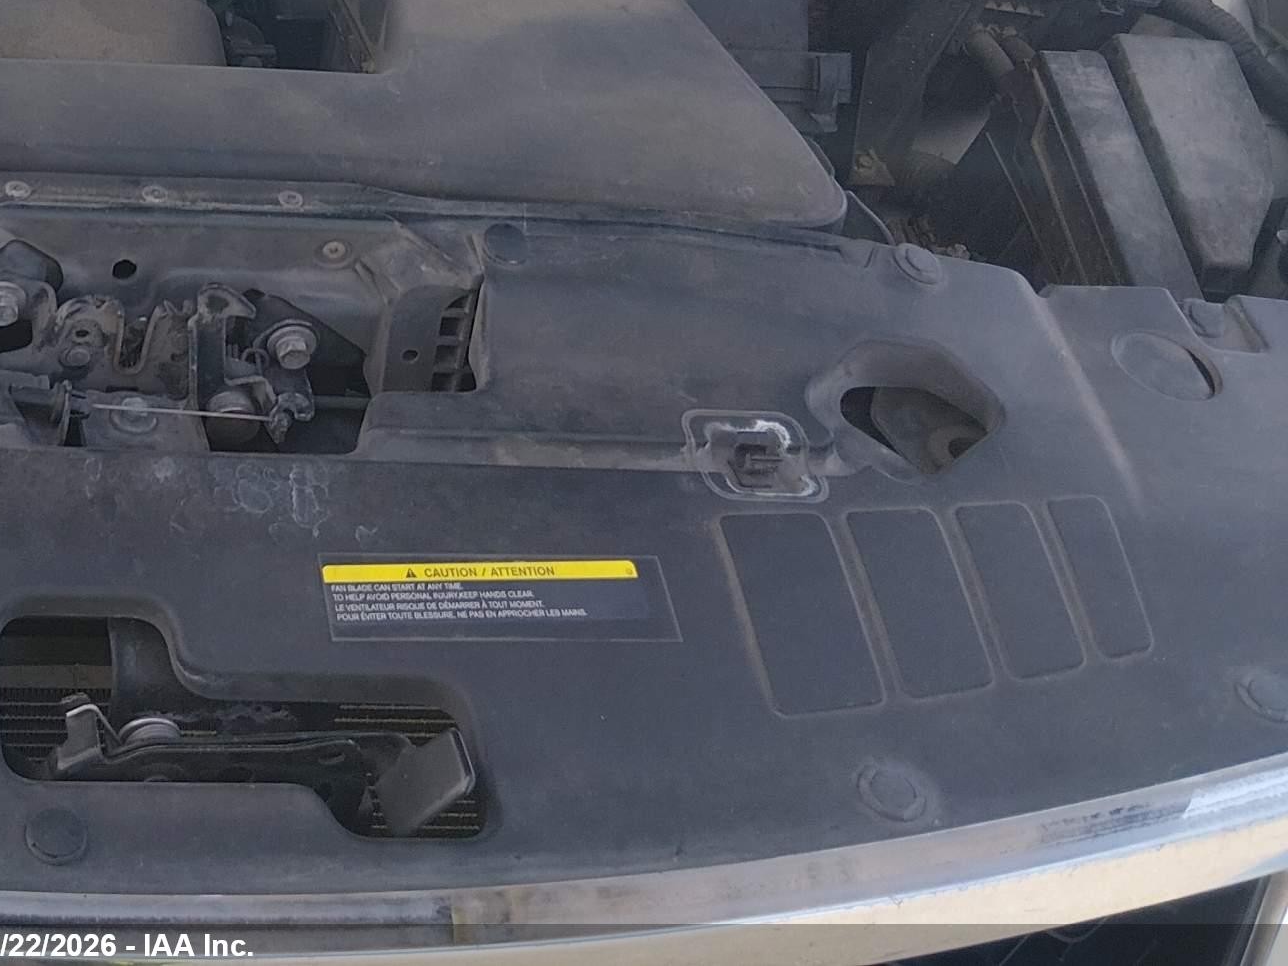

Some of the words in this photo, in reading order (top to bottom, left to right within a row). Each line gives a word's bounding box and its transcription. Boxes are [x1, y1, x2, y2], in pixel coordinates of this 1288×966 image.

[424, 567, 478, 578] CAUTION
[490, 566, 555, 577] ATTENTION
[330, 584, 346, 592] FAN
[347, 584, 372, 592] BLADE
[392, 583, 416, 591] START
[427, 582, 443, 590] ANY
[332, 593, 344, 601] TO
[345, 593, 365, 601] HELP
[366, 592, 390, 600] AVOID
[390, 592, 432, 600] PERSONAL
[479, 590, 506, 599] HANDS
[335, 604, 344, 612] LE
[346, 603, 396, 612] VENTILATEUR
[396, 602, 425, 611] RISQUE
[426, 602, 438, 610] DE
[489, 600, 508, 609] TOUT
[336, 613, 360, 622] POUR
[388, 612, 413, 620] TOUTE
[456, 610, 468, 619] NE
[469, 610, 484, 618] PAS
[486, 610, 497, 618] EN
[498, 609, 545, 618] APPROCHER
[546, 608, 561, 617] LES
